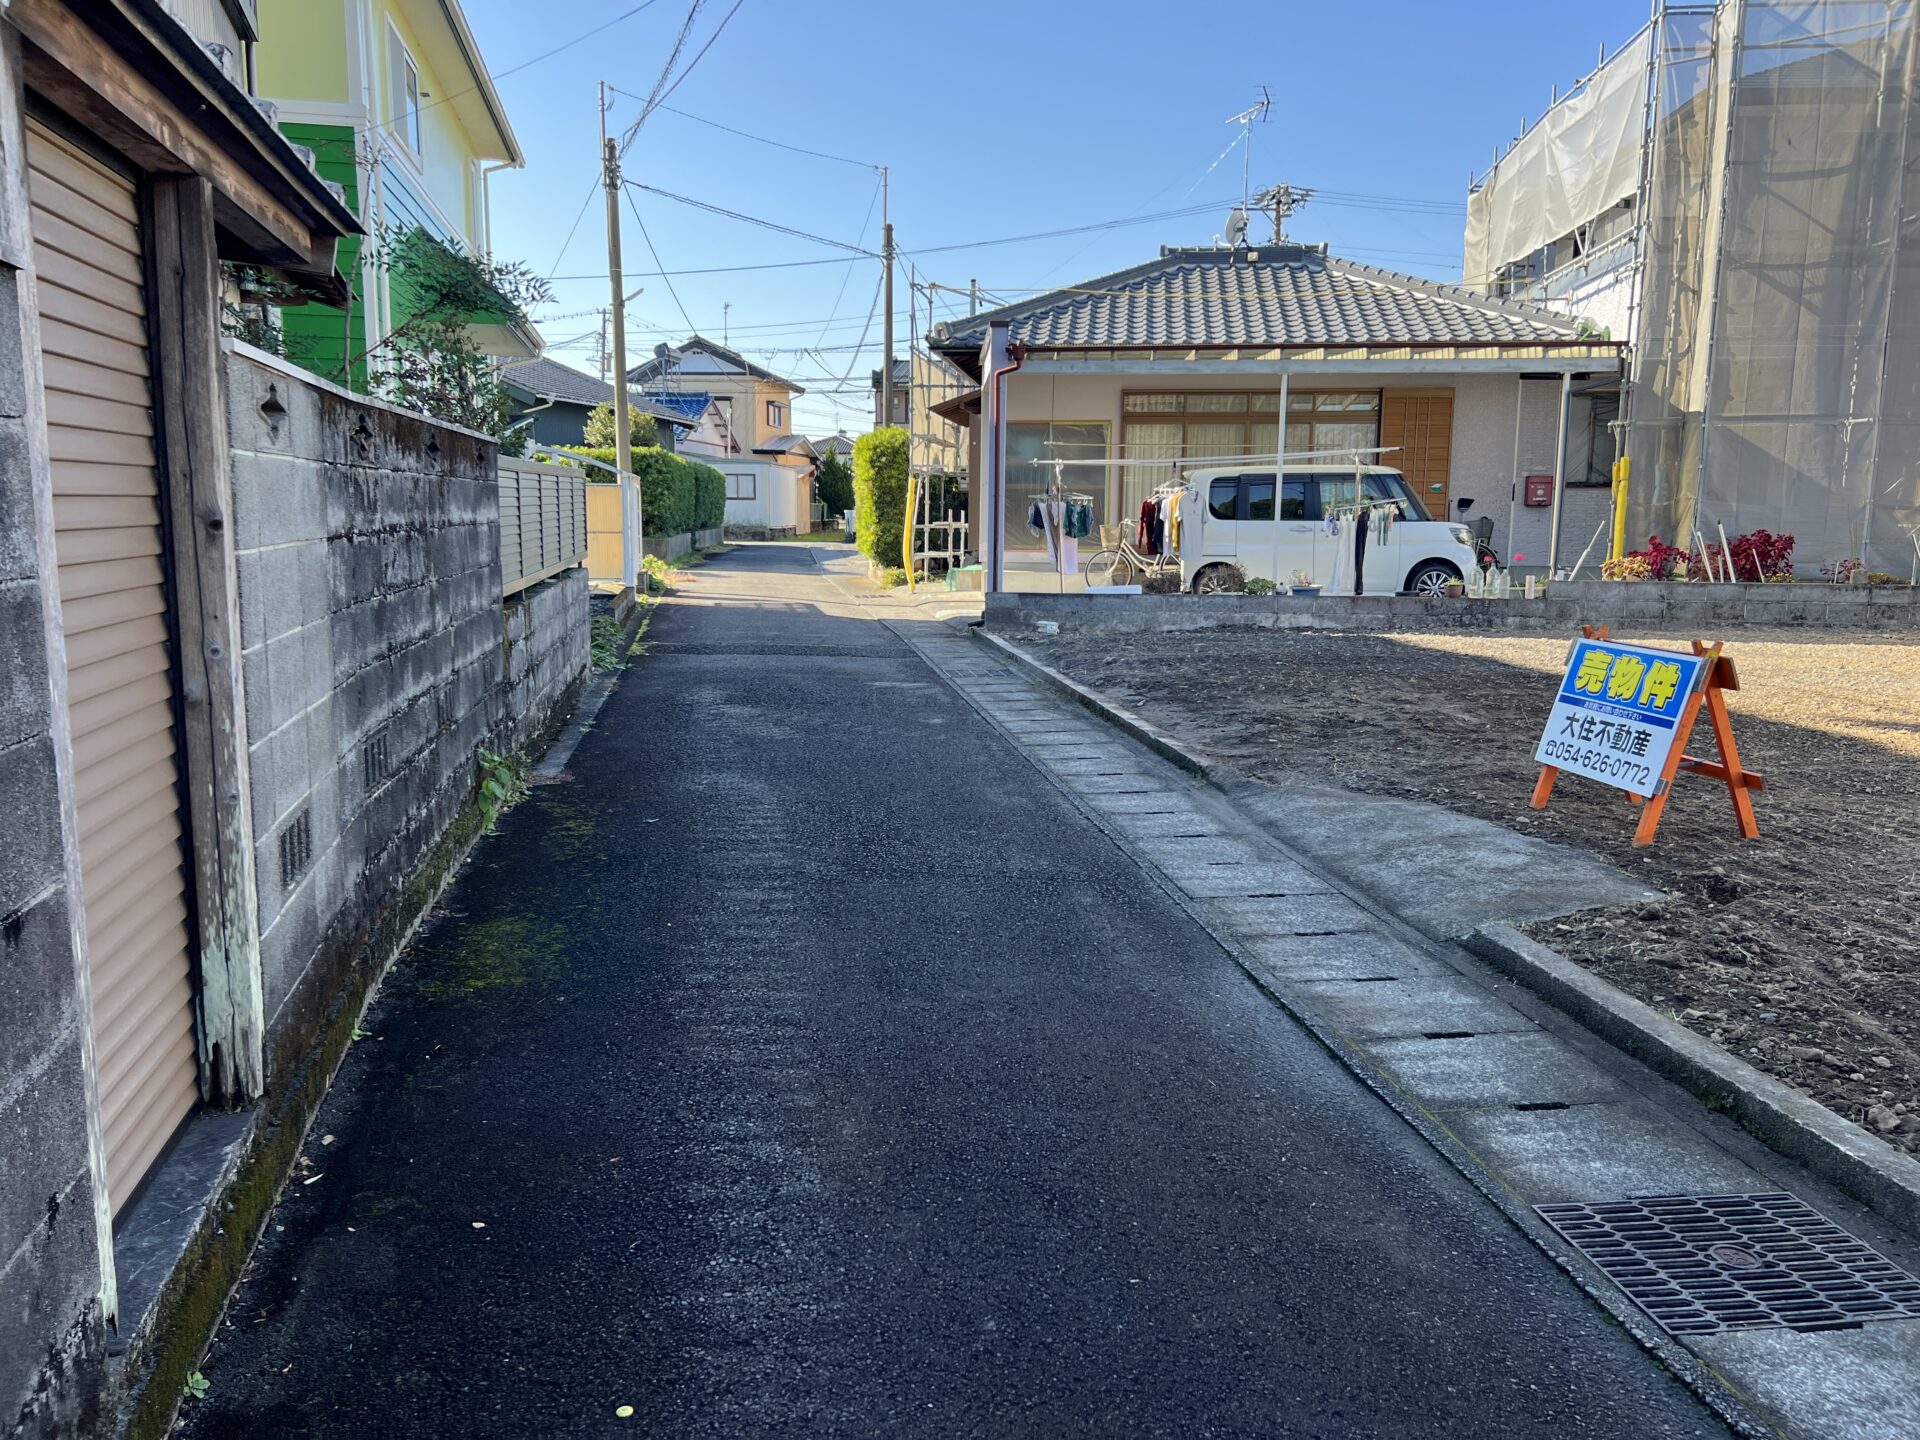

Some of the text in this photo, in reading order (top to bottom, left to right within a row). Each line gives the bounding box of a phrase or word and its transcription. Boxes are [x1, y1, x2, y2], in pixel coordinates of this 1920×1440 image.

[1574, 649, 1681, 709] 売物件
[1560, 711, 1653, 758] 大住不動産
